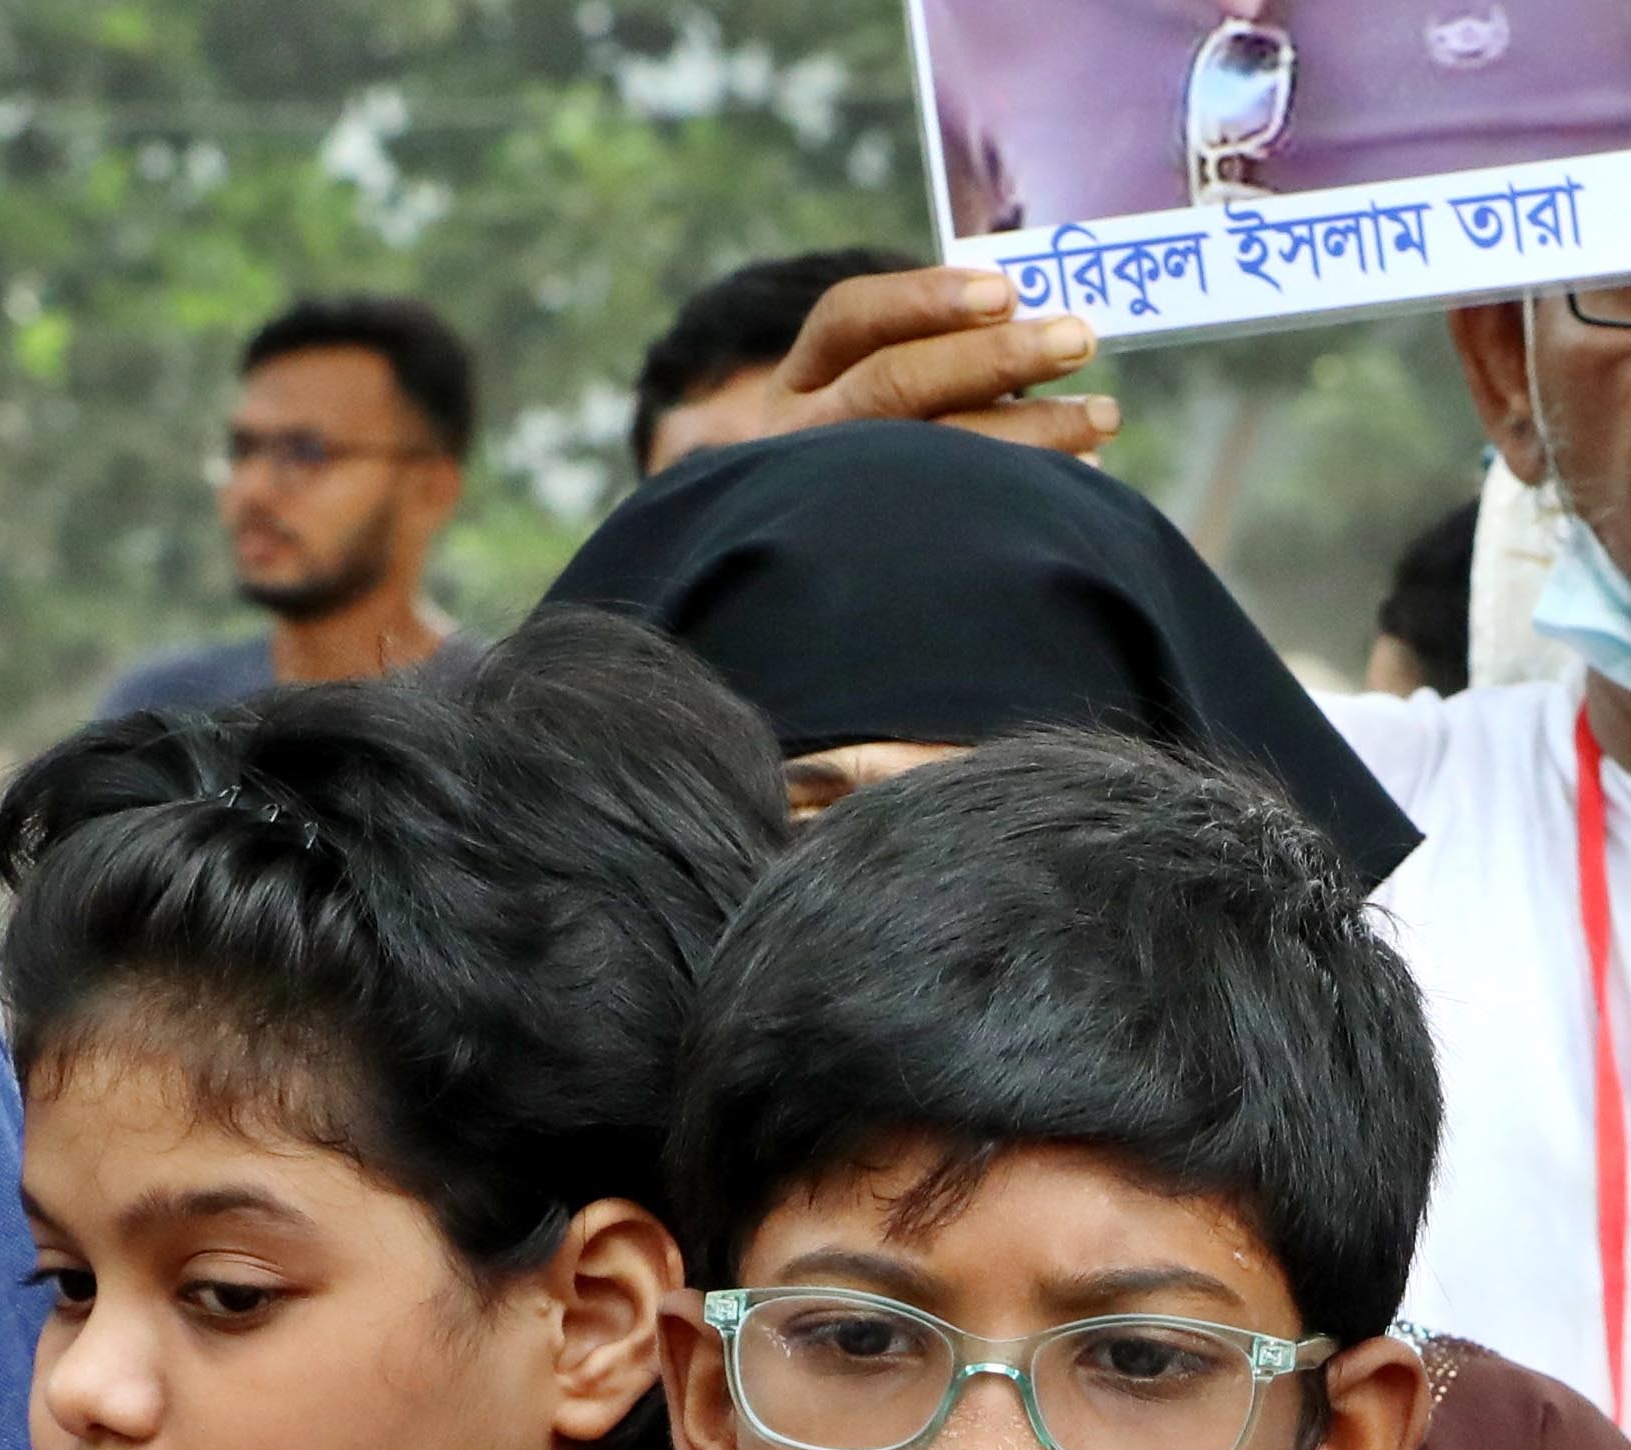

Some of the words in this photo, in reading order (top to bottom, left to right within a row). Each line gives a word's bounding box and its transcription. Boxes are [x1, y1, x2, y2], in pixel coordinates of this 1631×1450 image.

[998, 222, 1210, 317] তরিকুল
[1227, 201, 1432, 290] ইসলাম
[1451, 175, 1584, 253] তারা
